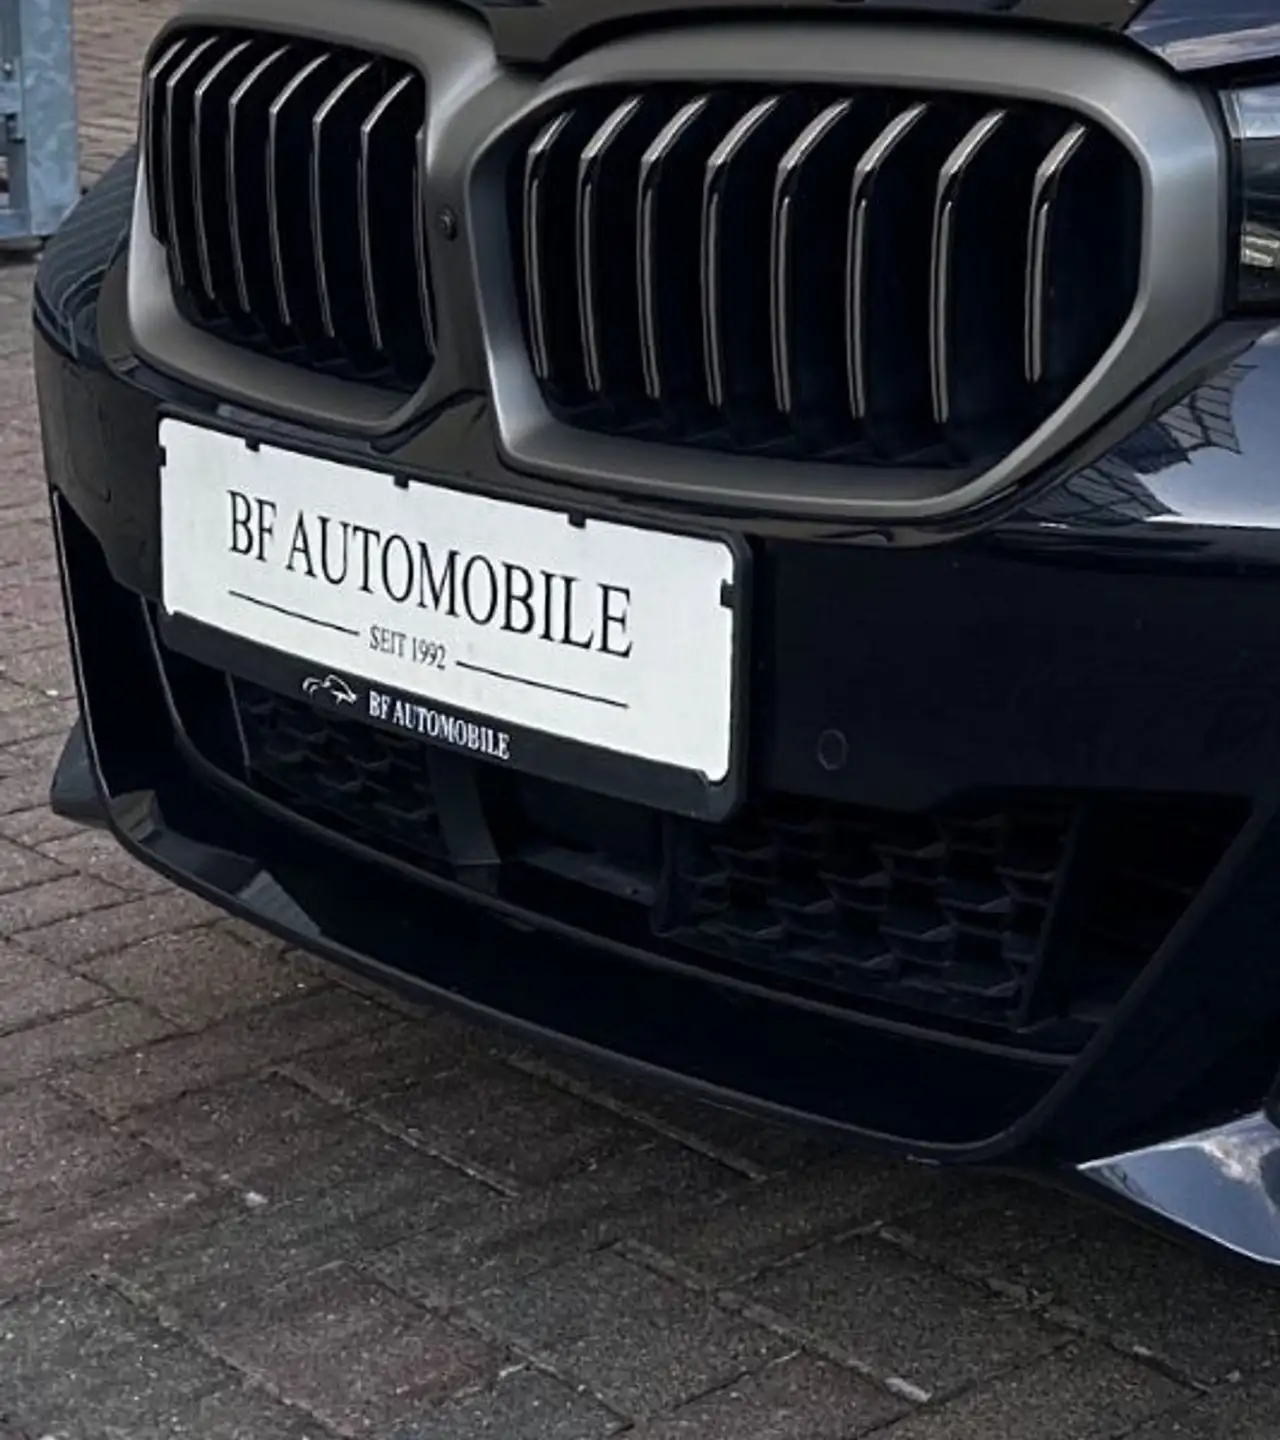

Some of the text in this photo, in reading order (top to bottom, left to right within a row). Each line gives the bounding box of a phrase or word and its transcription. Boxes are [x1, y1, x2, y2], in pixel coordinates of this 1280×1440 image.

[227, 490, 634, 658] BF AUTOMOBILE
[369, 625, 446, 670] SEIT 1992
[369, 690, 510, 759] BF AUTOMOBILE
